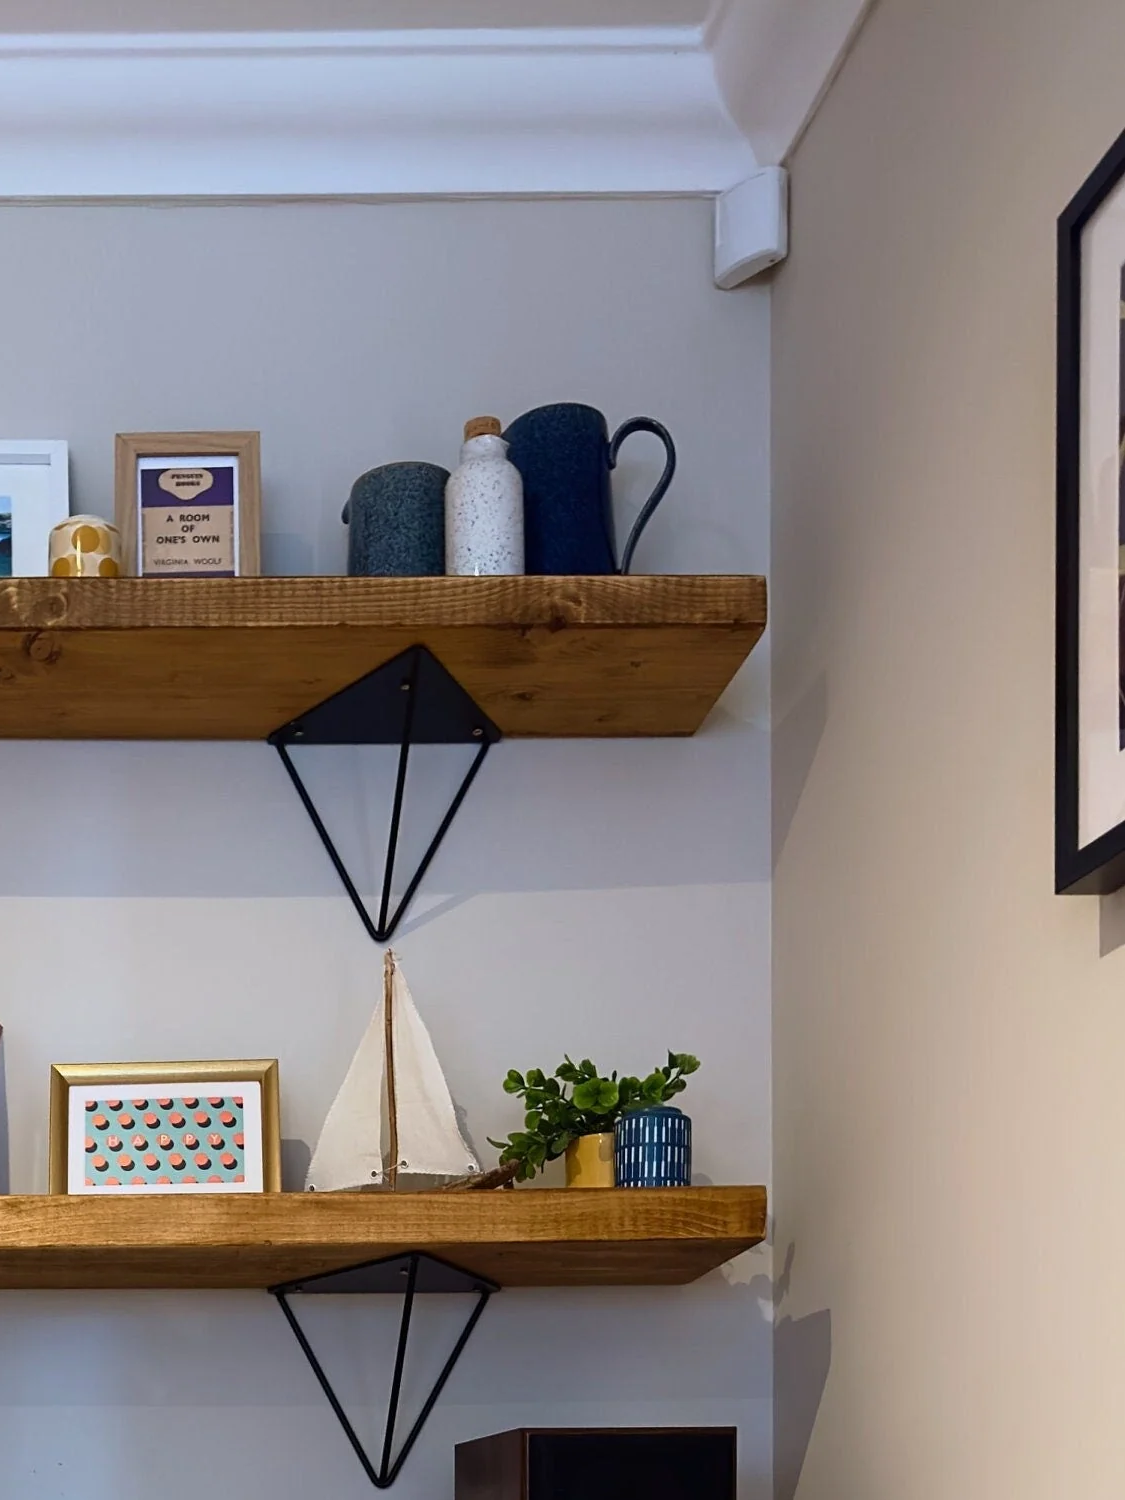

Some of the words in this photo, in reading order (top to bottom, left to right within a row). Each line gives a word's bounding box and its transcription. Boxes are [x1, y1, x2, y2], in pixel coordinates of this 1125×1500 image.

[166, 514, 174, 522] A
[181, 524, 195, 532] OF
[156, 536, 186, 544] ONE'S
[192, 535, 220, 544] OWN
[108, 1132, 218, 1147] HAPPY
